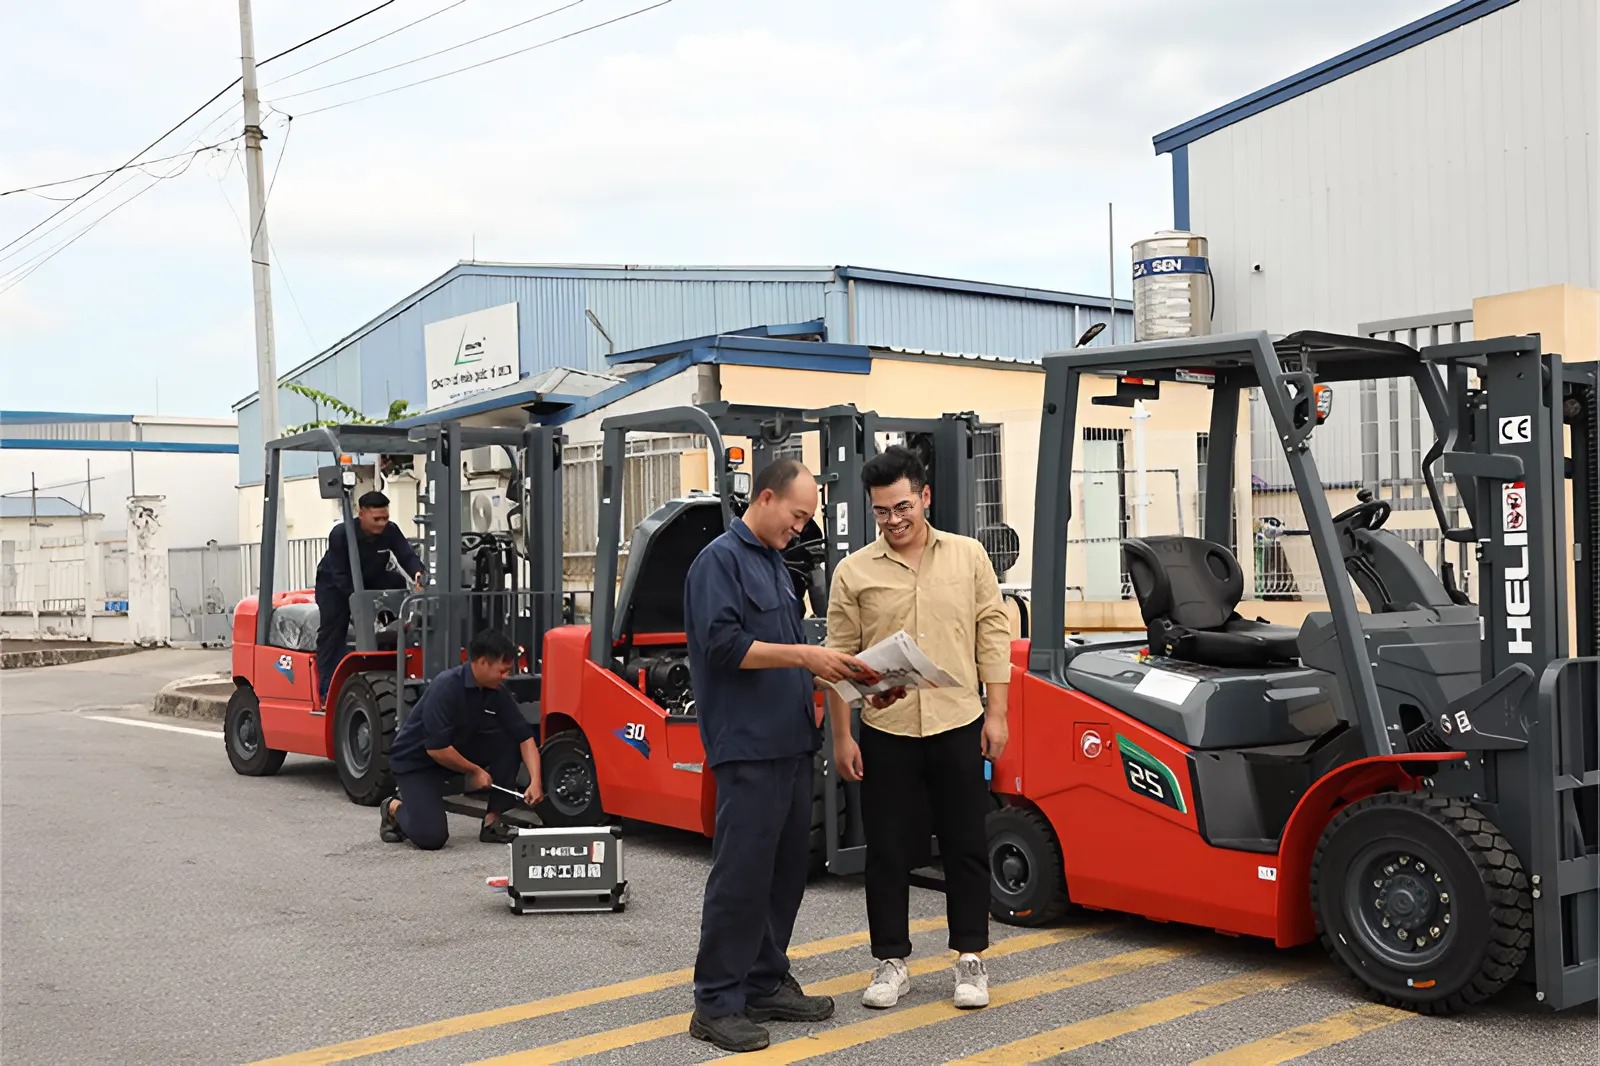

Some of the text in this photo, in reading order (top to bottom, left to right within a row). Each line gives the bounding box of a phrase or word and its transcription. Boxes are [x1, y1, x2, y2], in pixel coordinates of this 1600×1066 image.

[1501, 417, 1529, 440] CE
[1503, 532, 1533, 654] HELI
[624, 722, 645, 741] 30
[1128, 761, 1164, 799] 25
